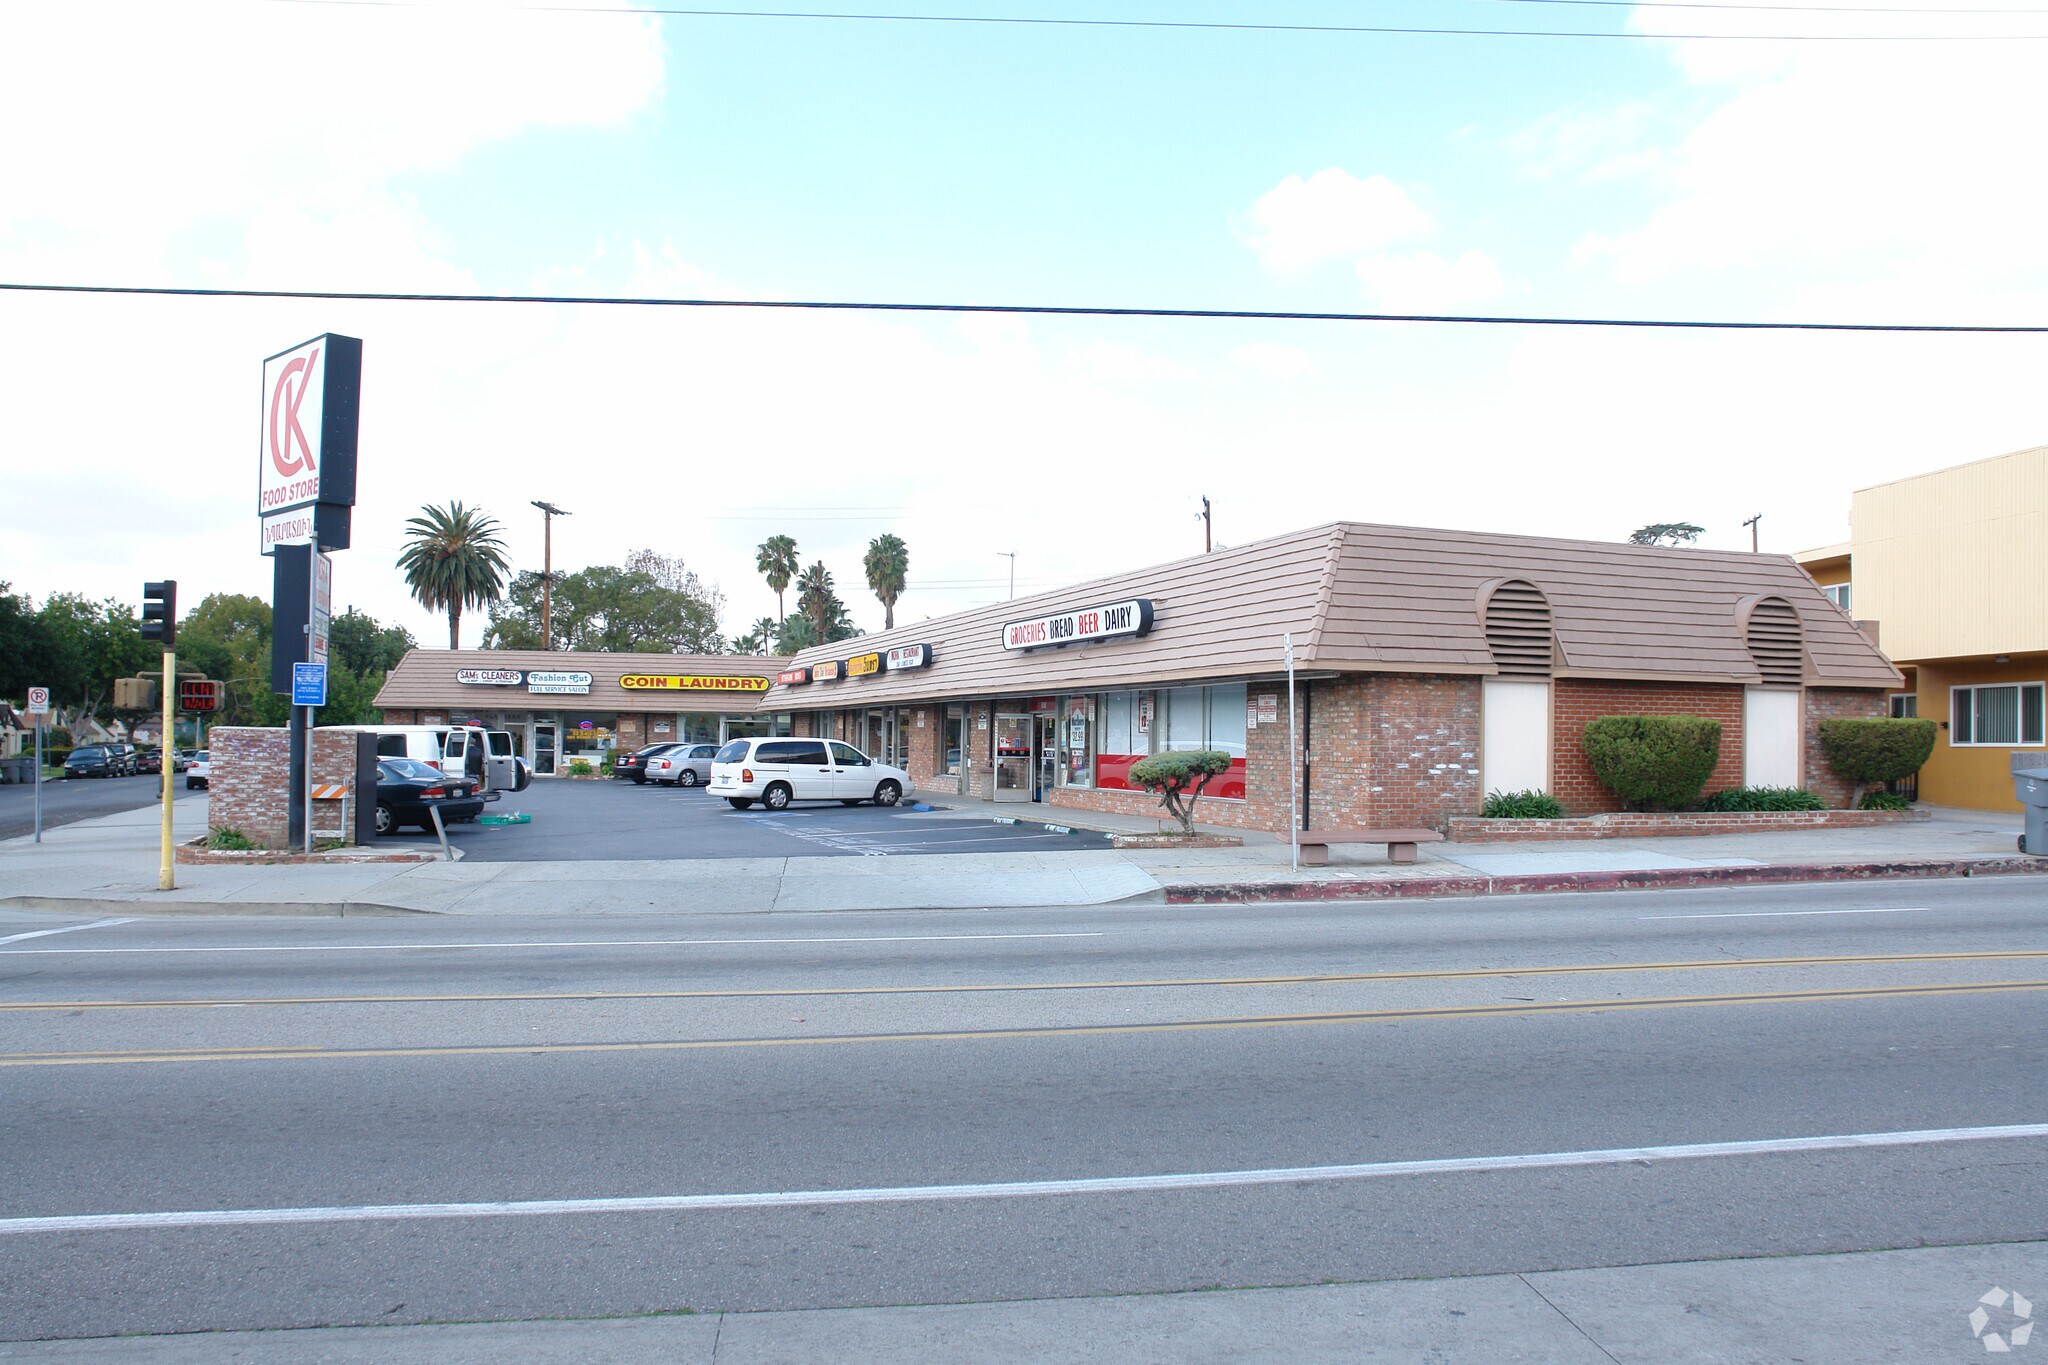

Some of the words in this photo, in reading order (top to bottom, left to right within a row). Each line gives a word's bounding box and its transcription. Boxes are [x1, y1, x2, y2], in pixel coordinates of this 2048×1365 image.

[262, 486, 287, 508] FOOD
[289, 477, 319, 501] STORE
[1010, 622, 1046, 645] GROCERIES
[1050, 617, 1074, 639] BREAD
[1078, 612, 1099, 635] BEER
[1104, 606, 1132, 631] DAIRY
[481, 671, 519, 681] CLEANERS
[530, 673, 567, 683] Fashion
[570, 674, 588, 683] Cut
[623, 677, 667, 687] COIN
[679, 677, 765, 688] LAUNDRY
